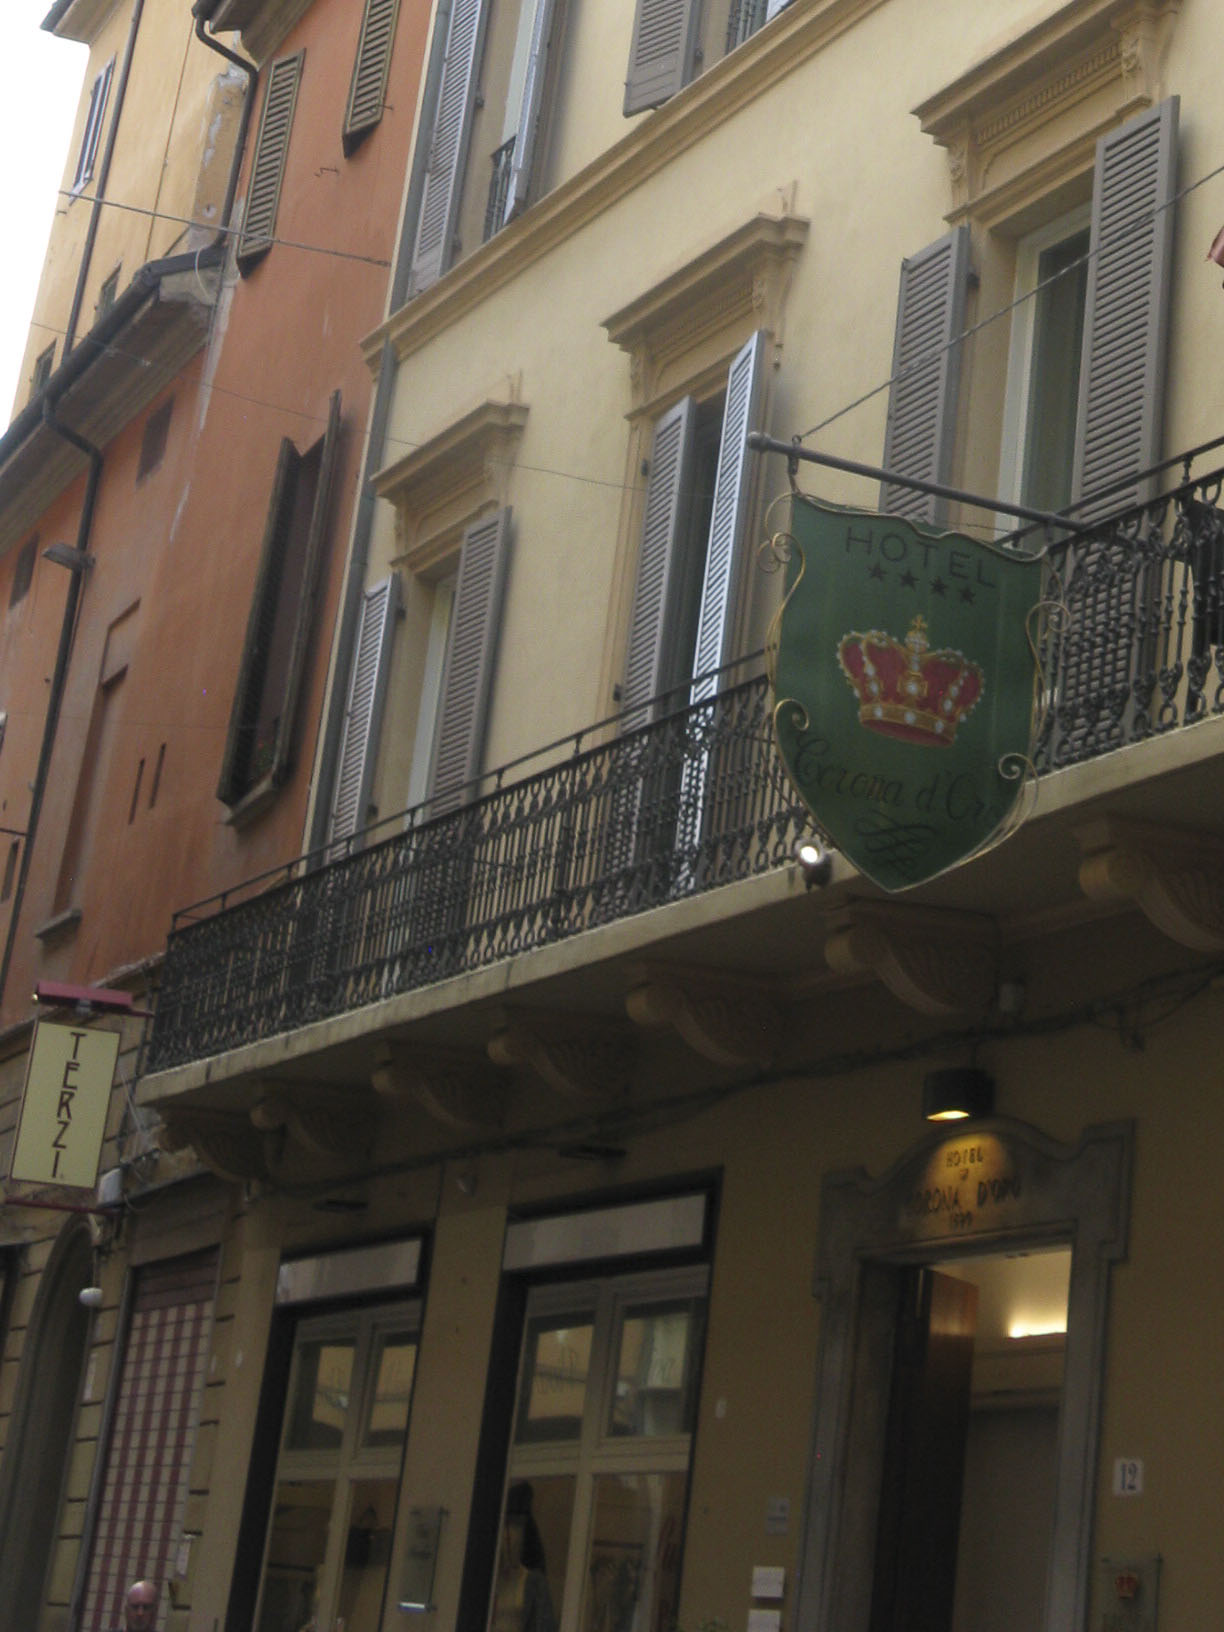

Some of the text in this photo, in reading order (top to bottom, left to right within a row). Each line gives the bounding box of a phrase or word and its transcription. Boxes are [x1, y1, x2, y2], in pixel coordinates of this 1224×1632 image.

[845, 526, 996, 589] HOTEL
[51, 1031, 87, 1179] TERZI
[945, 1145, 984, 1168] HOTEL
[1120, 1463, 1138, 1490] 12
